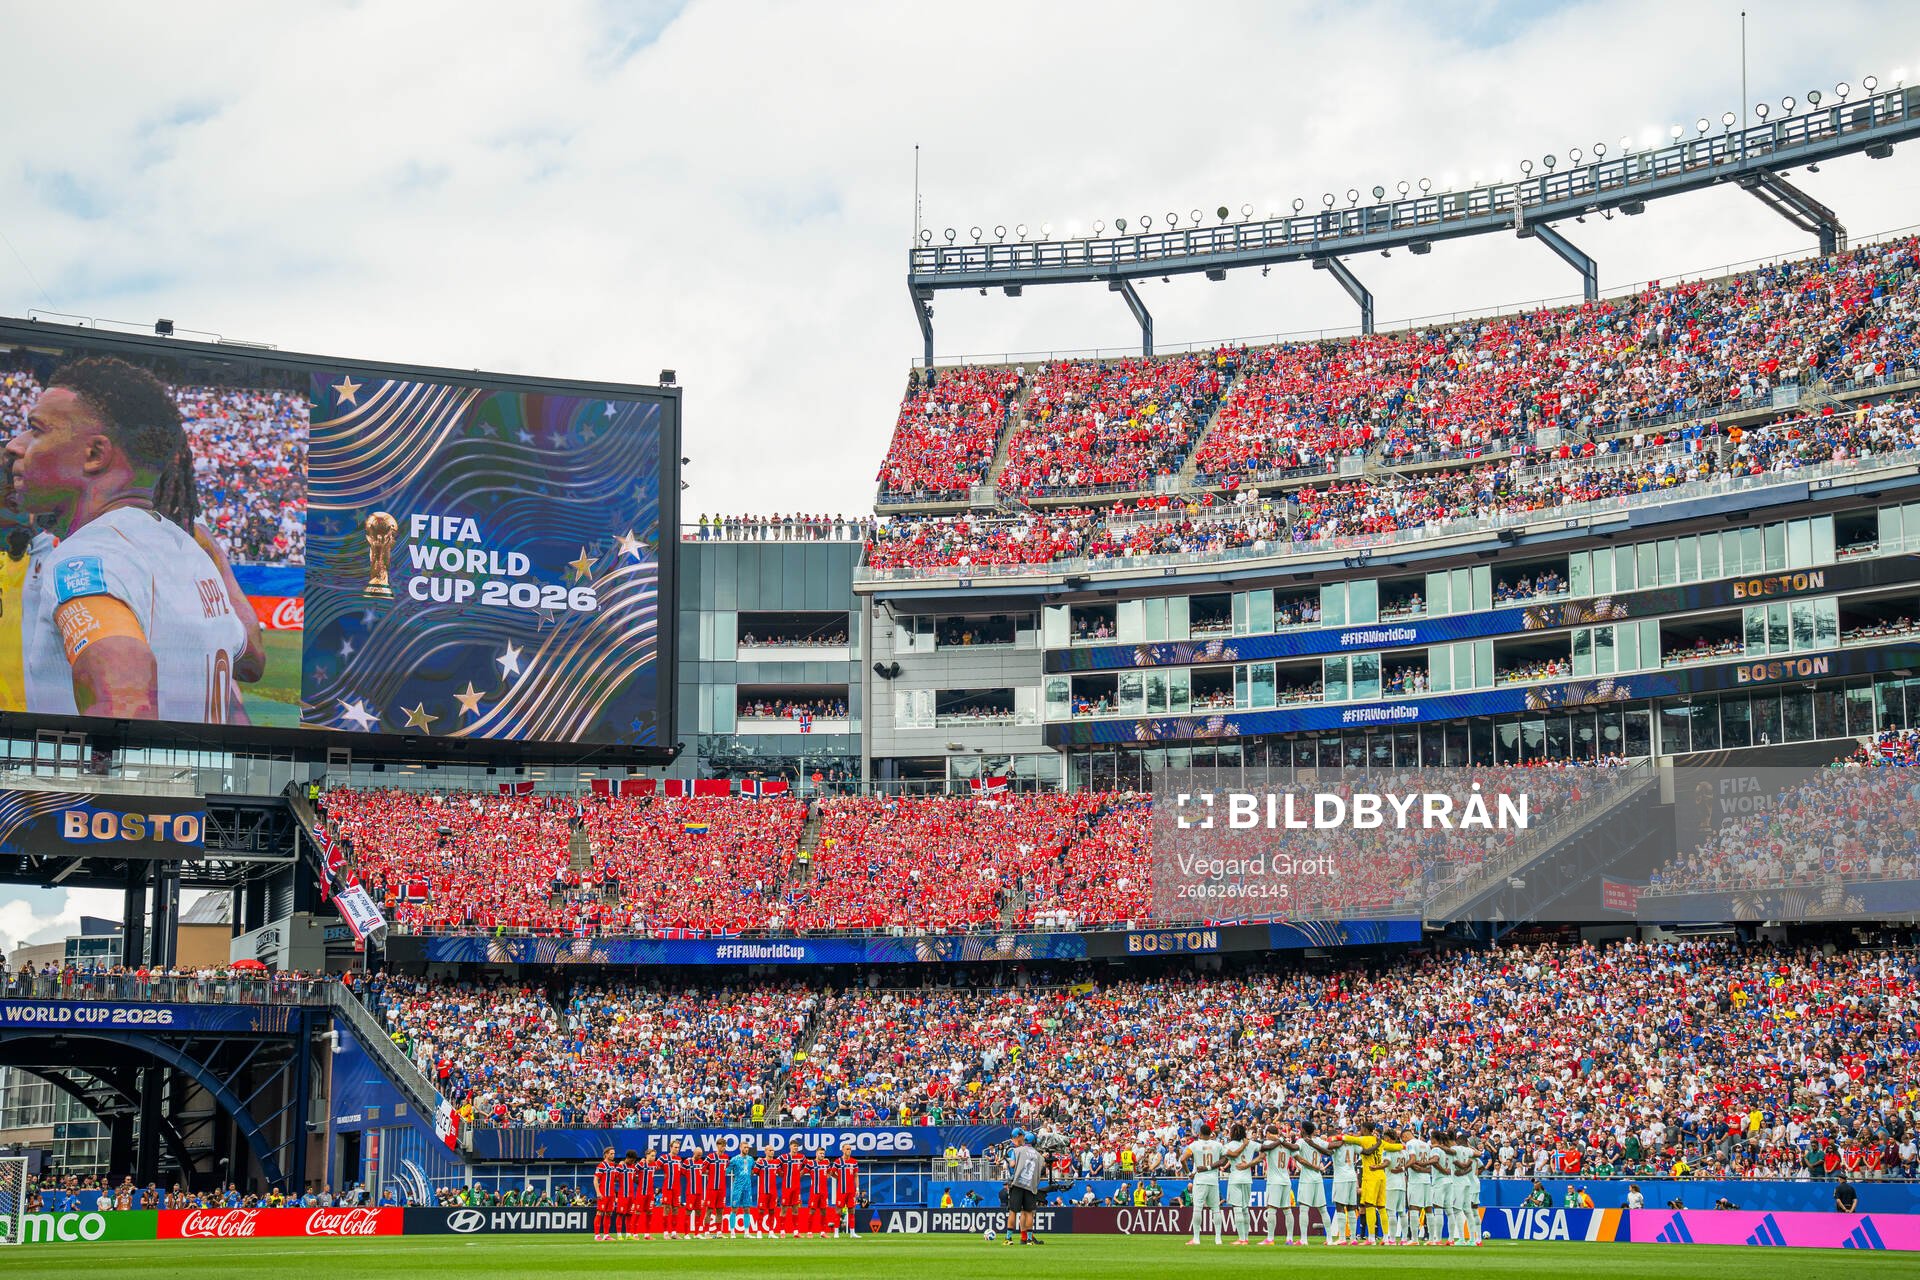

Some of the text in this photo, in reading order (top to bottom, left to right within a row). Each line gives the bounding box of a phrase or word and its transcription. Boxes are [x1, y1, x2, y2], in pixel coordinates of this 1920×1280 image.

[410, 513, 482, 543] FIFA
[408, 544, 531, 577] WORLD
[408, 576, 598, 612] CUP 2026
[1733, 571, 1825, 599] BOSTON
[1340, 628, 1417, 645] #FIFAWorldCup
[1737, 656, 1829, 683] BOSTON
[1342, 706, 1419, 723] #FIFAWorldCup
[1720, 777, 1761, 795] FIFA
[1720, 794, 1774, 814] WORL
[64, 811, 206, 843] BOSTO
[716, 944, 805, 960] #FIFAWorldCup
[1128, 931, 1218, 952] BOSTON
[5, 1006, 71, 1022] WORLD
[74, 1007, 110, 1023] CUP
[112, 1009, 173, 1024] 2026
[648, 1132, 914, 1152] FIFA WORLD CUP 2026
[1278, 1151, 1286, 1169] 19
[181, 1209, 261, 1237] Coca-Cola
[305, 1208, 381, 1235] Coca-Cola
[491, 1212, 588, 1229] HYUNDAI
[886, 1211, 1056, 1233] ADI PREDICTSET
[1117, 1209, 1180, 1234] QATAR
[1500, 1209, 1570, 1240] VISA
